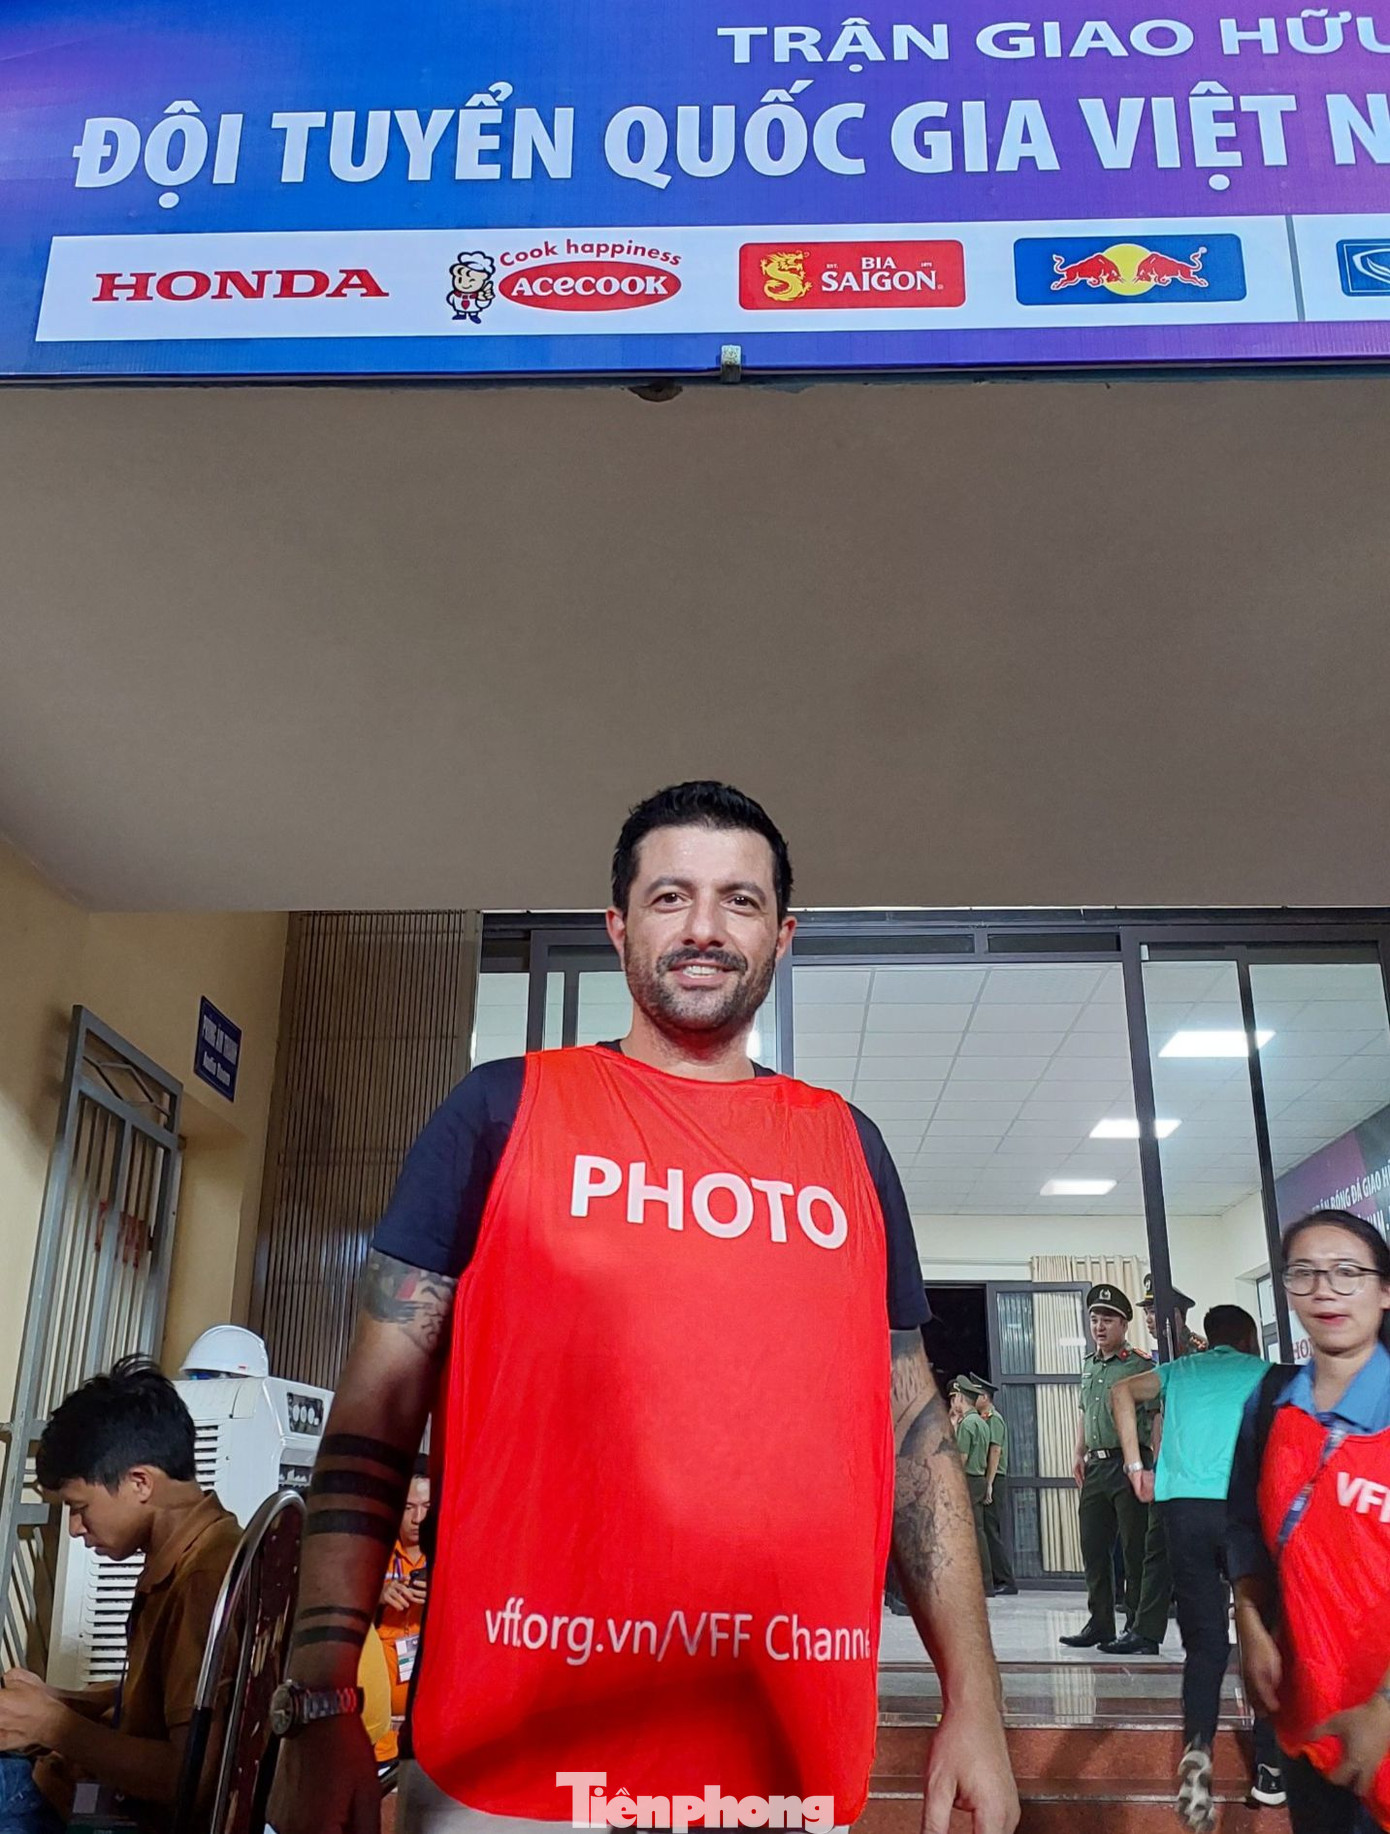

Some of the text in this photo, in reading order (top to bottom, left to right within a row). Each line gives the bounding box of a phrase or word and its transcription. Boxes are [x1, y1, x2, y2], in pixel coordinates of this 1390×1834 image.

[716, 17, 949, 73] TRẬN
[975, 18, 1195, 60] GIAO
[72, 100, 244, 209] ĐỘI
[270, 81, 575, 183] TUYỂN
[604, 79, 867, 190] QUỐC
[890, 99, 1061, 174] GIA
[1078, 80, 1297, 191] VIỆT
[500, 238, 682, 266] Cook happiness
[861, 256, 897, 270] BIA
[92, 269, 389, 302] HONDA
[821, 270, 937, 292] SAIGON
[570, 1154, 849, 1250] PHOTO
